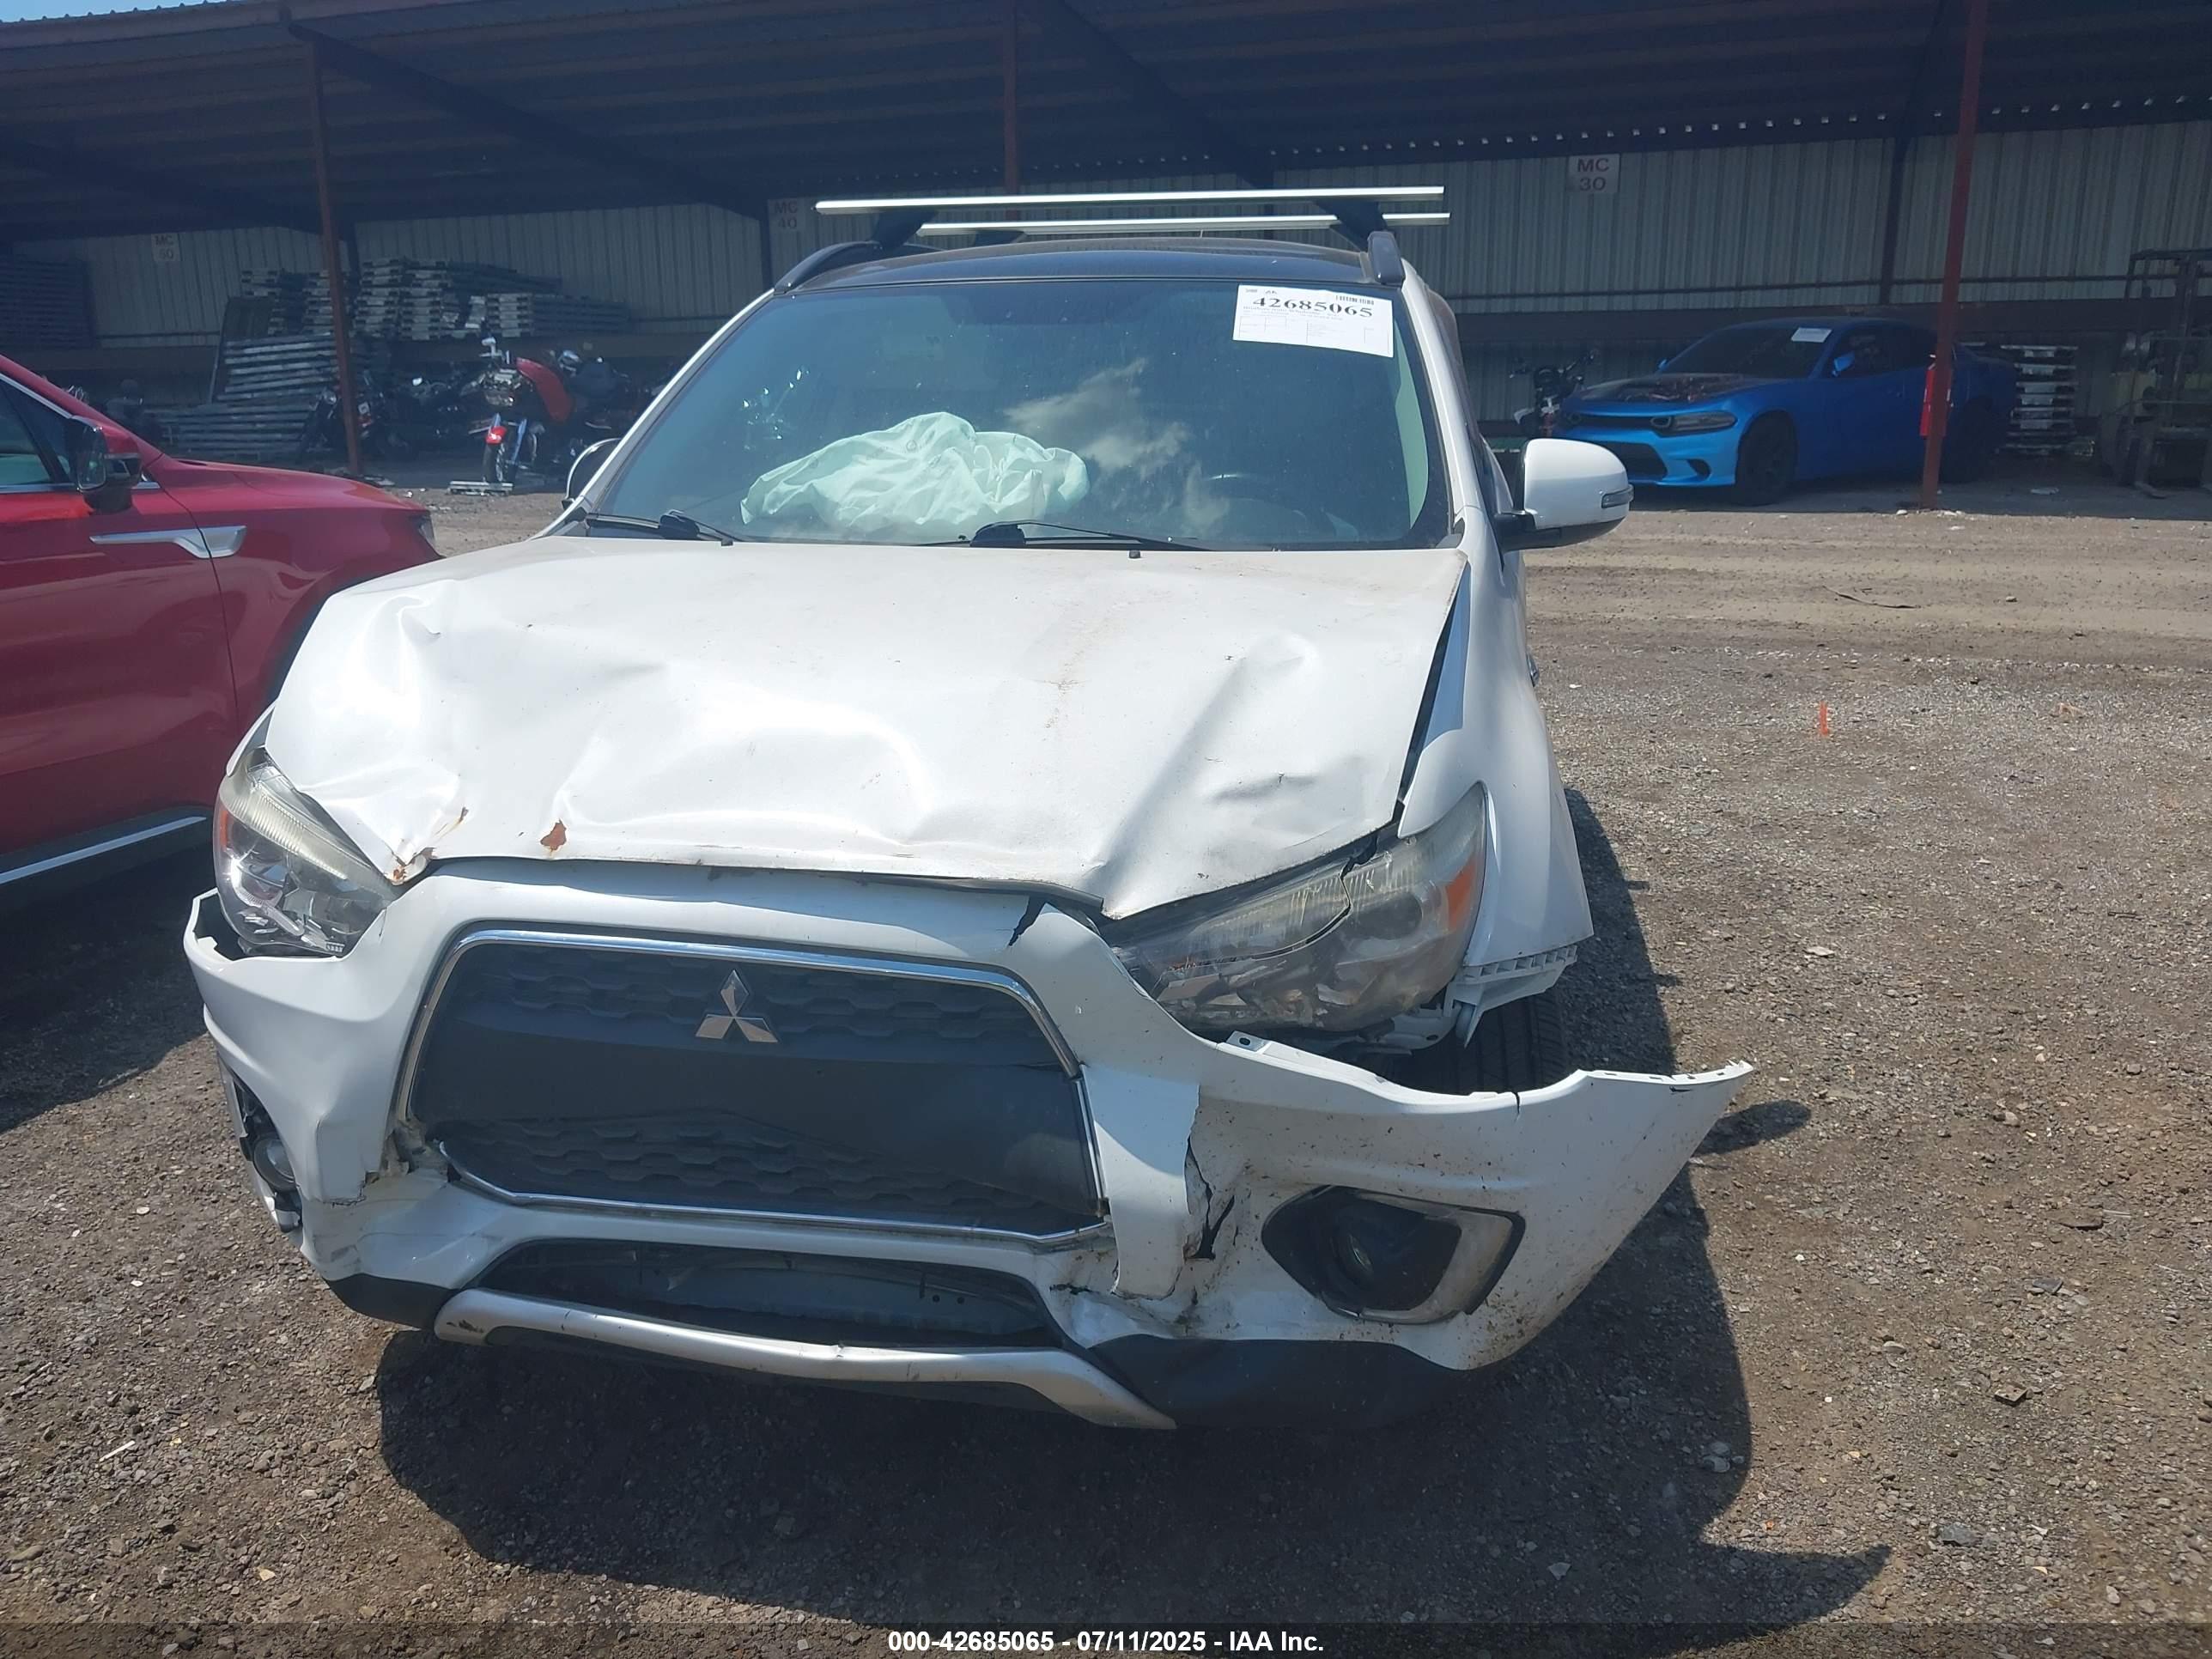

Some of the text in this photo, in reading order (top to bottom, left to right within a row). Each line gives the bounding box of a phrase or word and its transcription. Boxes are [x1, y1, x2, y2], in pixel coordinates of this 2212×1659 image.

[1577, 158, 1609, 172] MC
[1580, 177, 1607, 191] 30
[1253, 297, 1373, 318] 42685065
